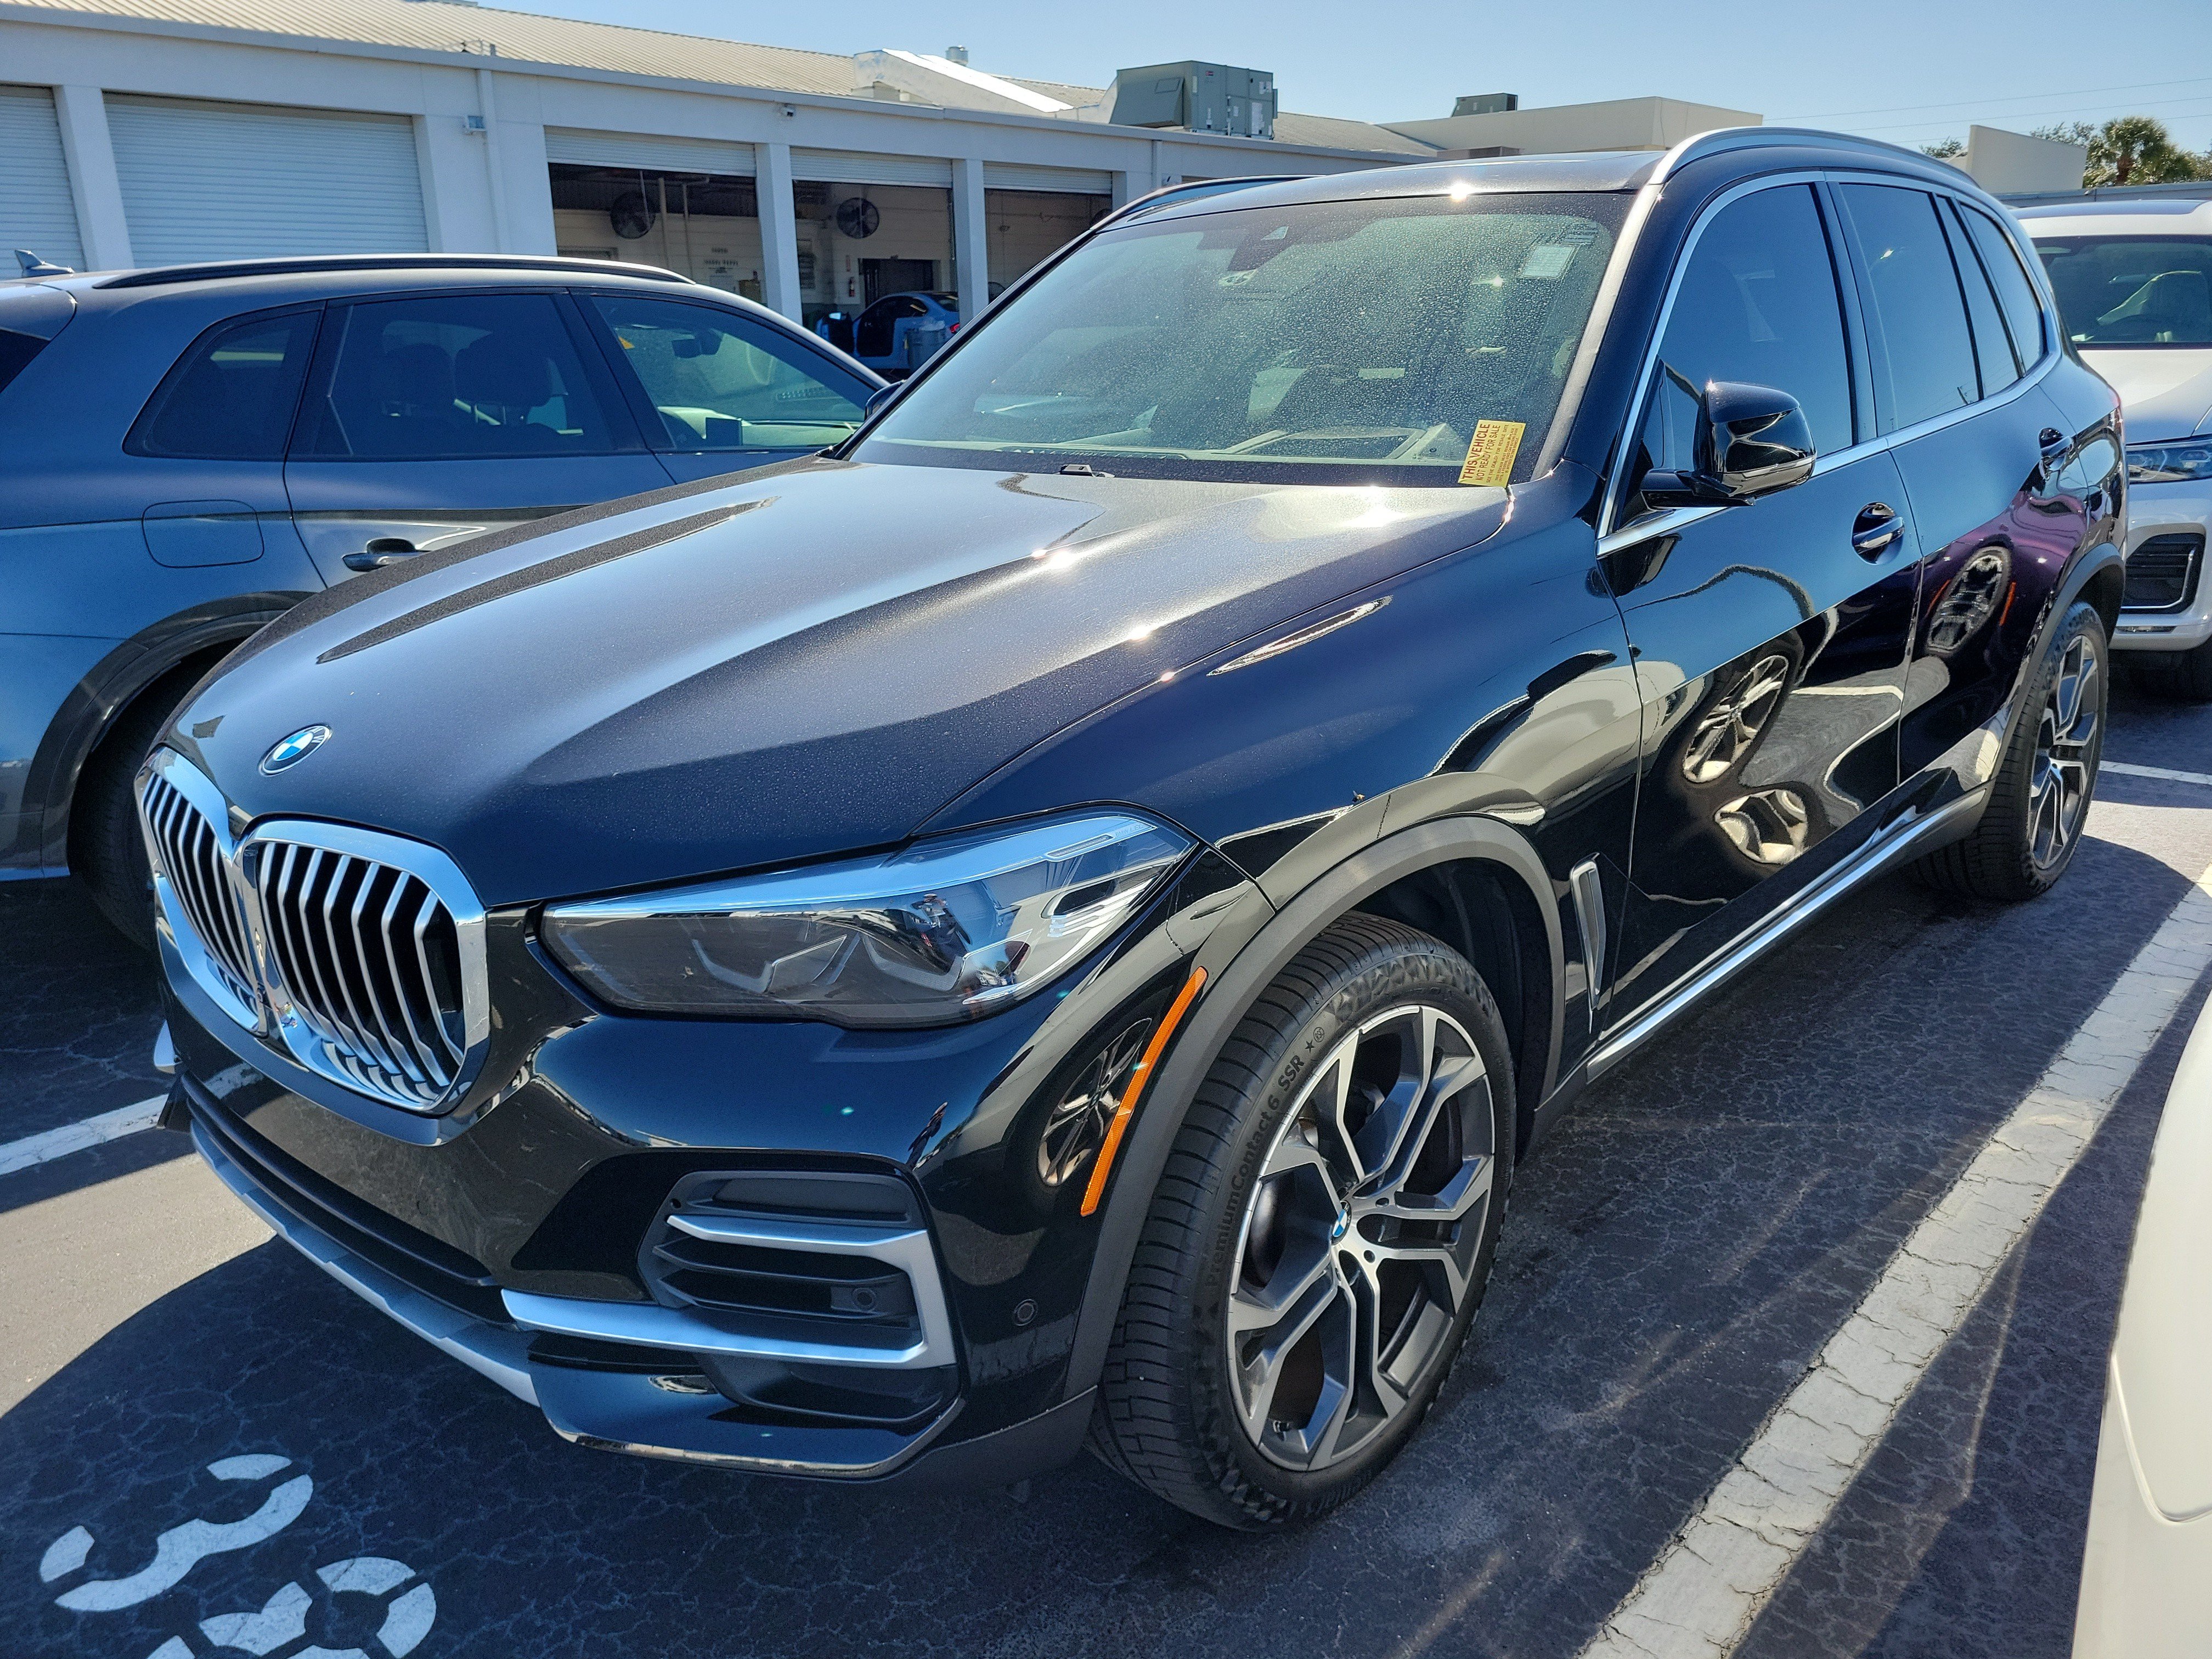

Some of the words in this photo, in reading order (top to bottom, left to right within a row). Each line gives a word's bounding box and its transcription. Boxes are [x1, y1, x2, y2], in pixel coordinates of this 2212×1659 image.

[1489, 425, 1500, 438] SALE
[1469, 424, 1490, 458] VEHICLE
[1485, 439, 1496, 449] FOR
[1479, 450, 1492, 468] READY
[1462, 460, 1477, 479] THIS
[1476, 469, 1486, 480] NOT
[1206, 1111, 1274, 1288] PremiumContact
[1278, 1054, 1304, 1092] SSR
